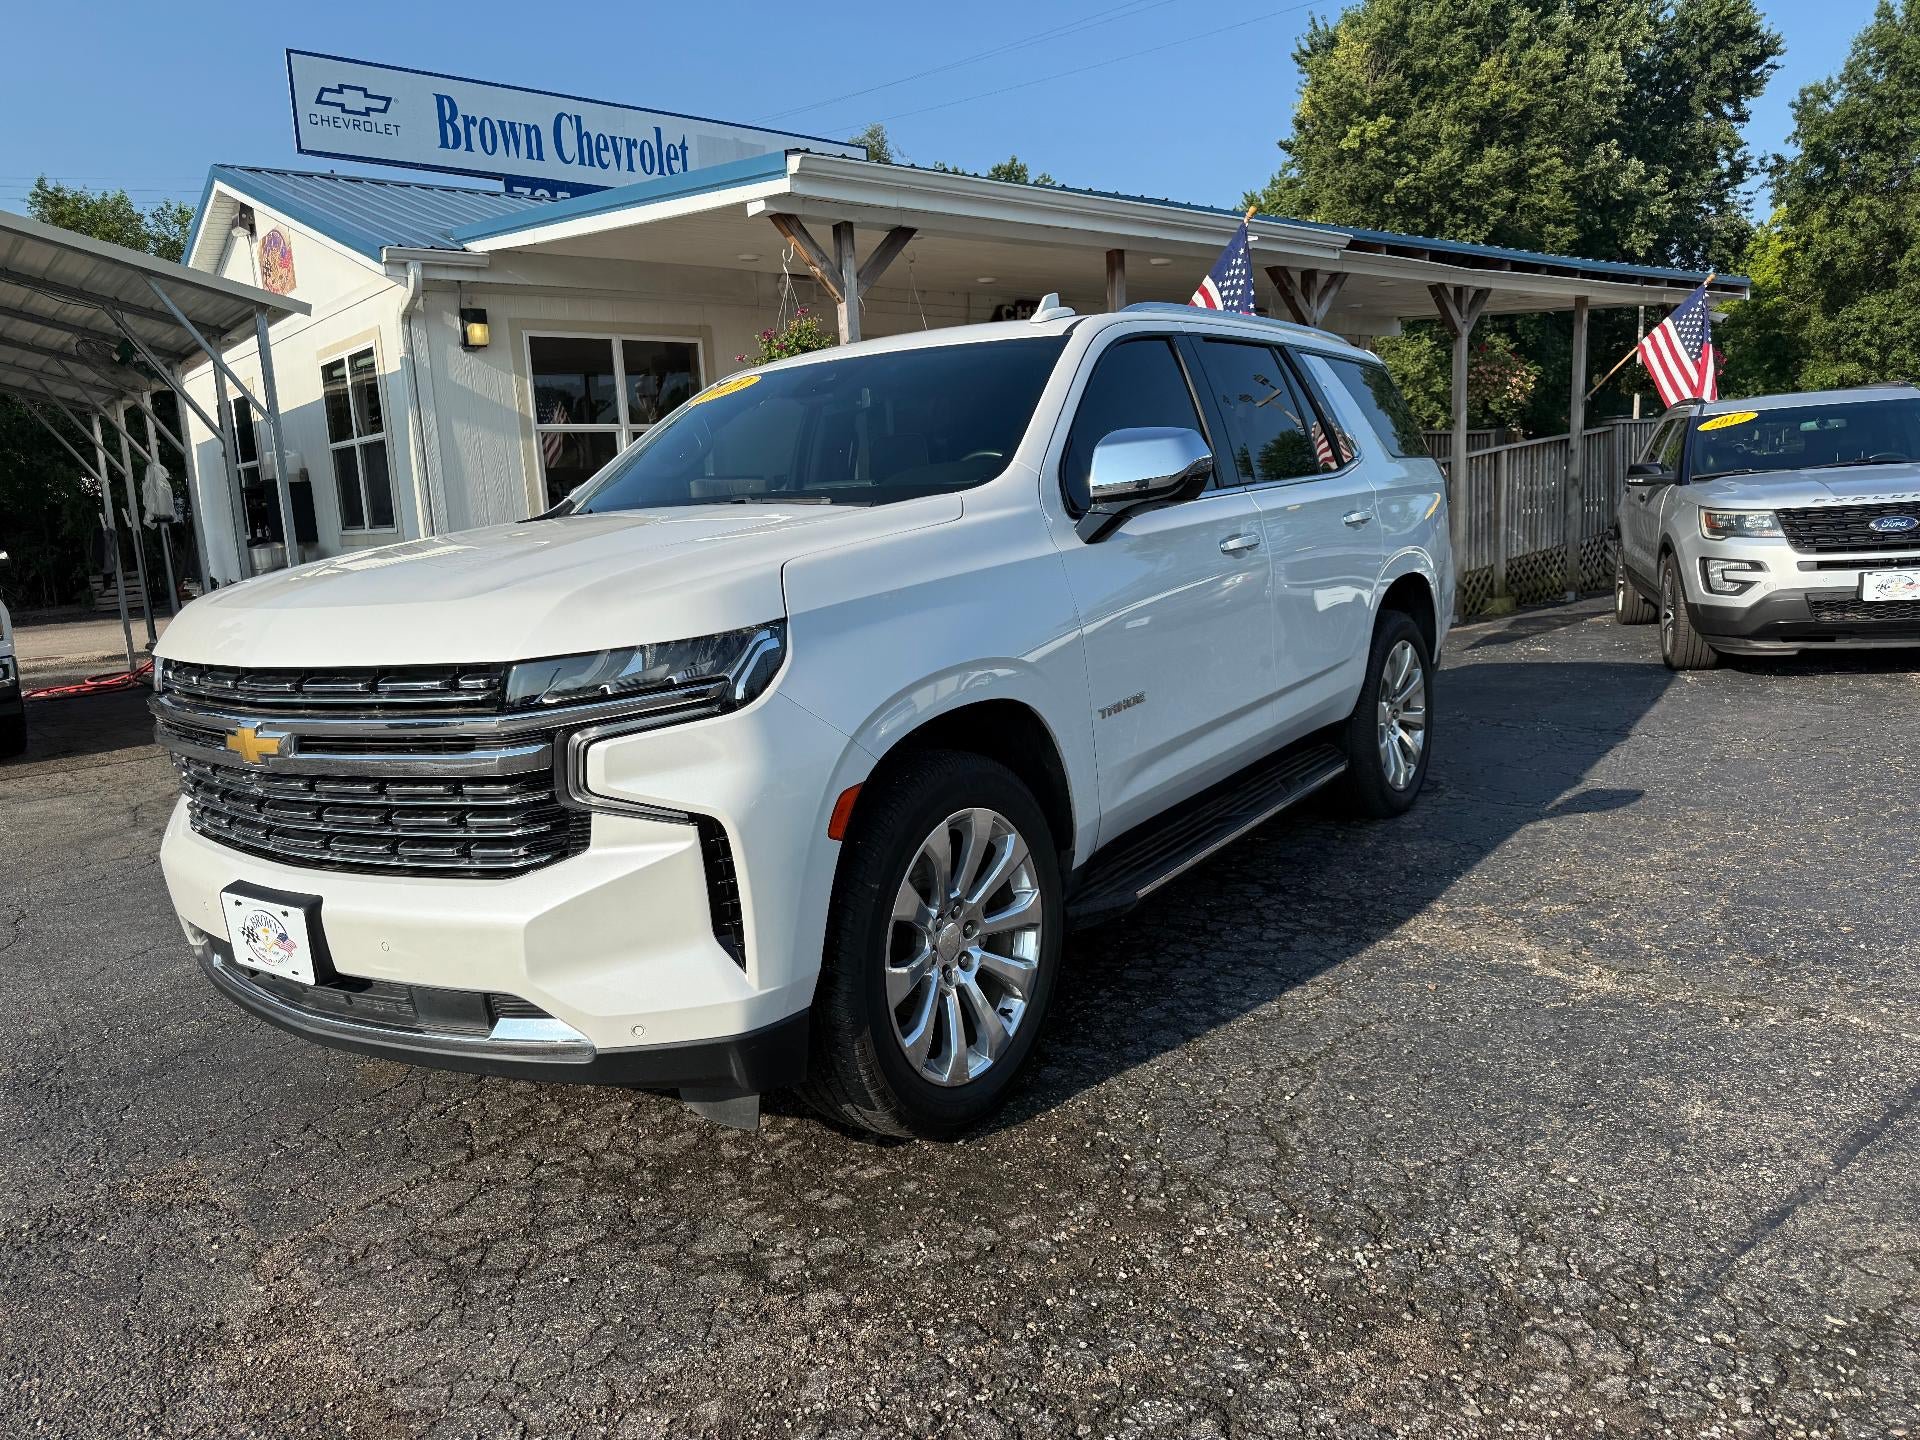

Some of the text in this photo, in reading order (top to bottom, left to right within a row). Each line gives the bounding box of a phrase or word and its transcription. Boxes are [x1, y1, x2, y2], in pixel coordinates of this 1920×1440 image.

[309, 113, 400, 137] CHEVROLET
[432, 92, 689, 177] Brown Chevrolet
[1710, 413, 1747, 428] 2017
[1881, 518, 1908, 528] Ford
[1098, 690, 1146, 720] TAHOE
